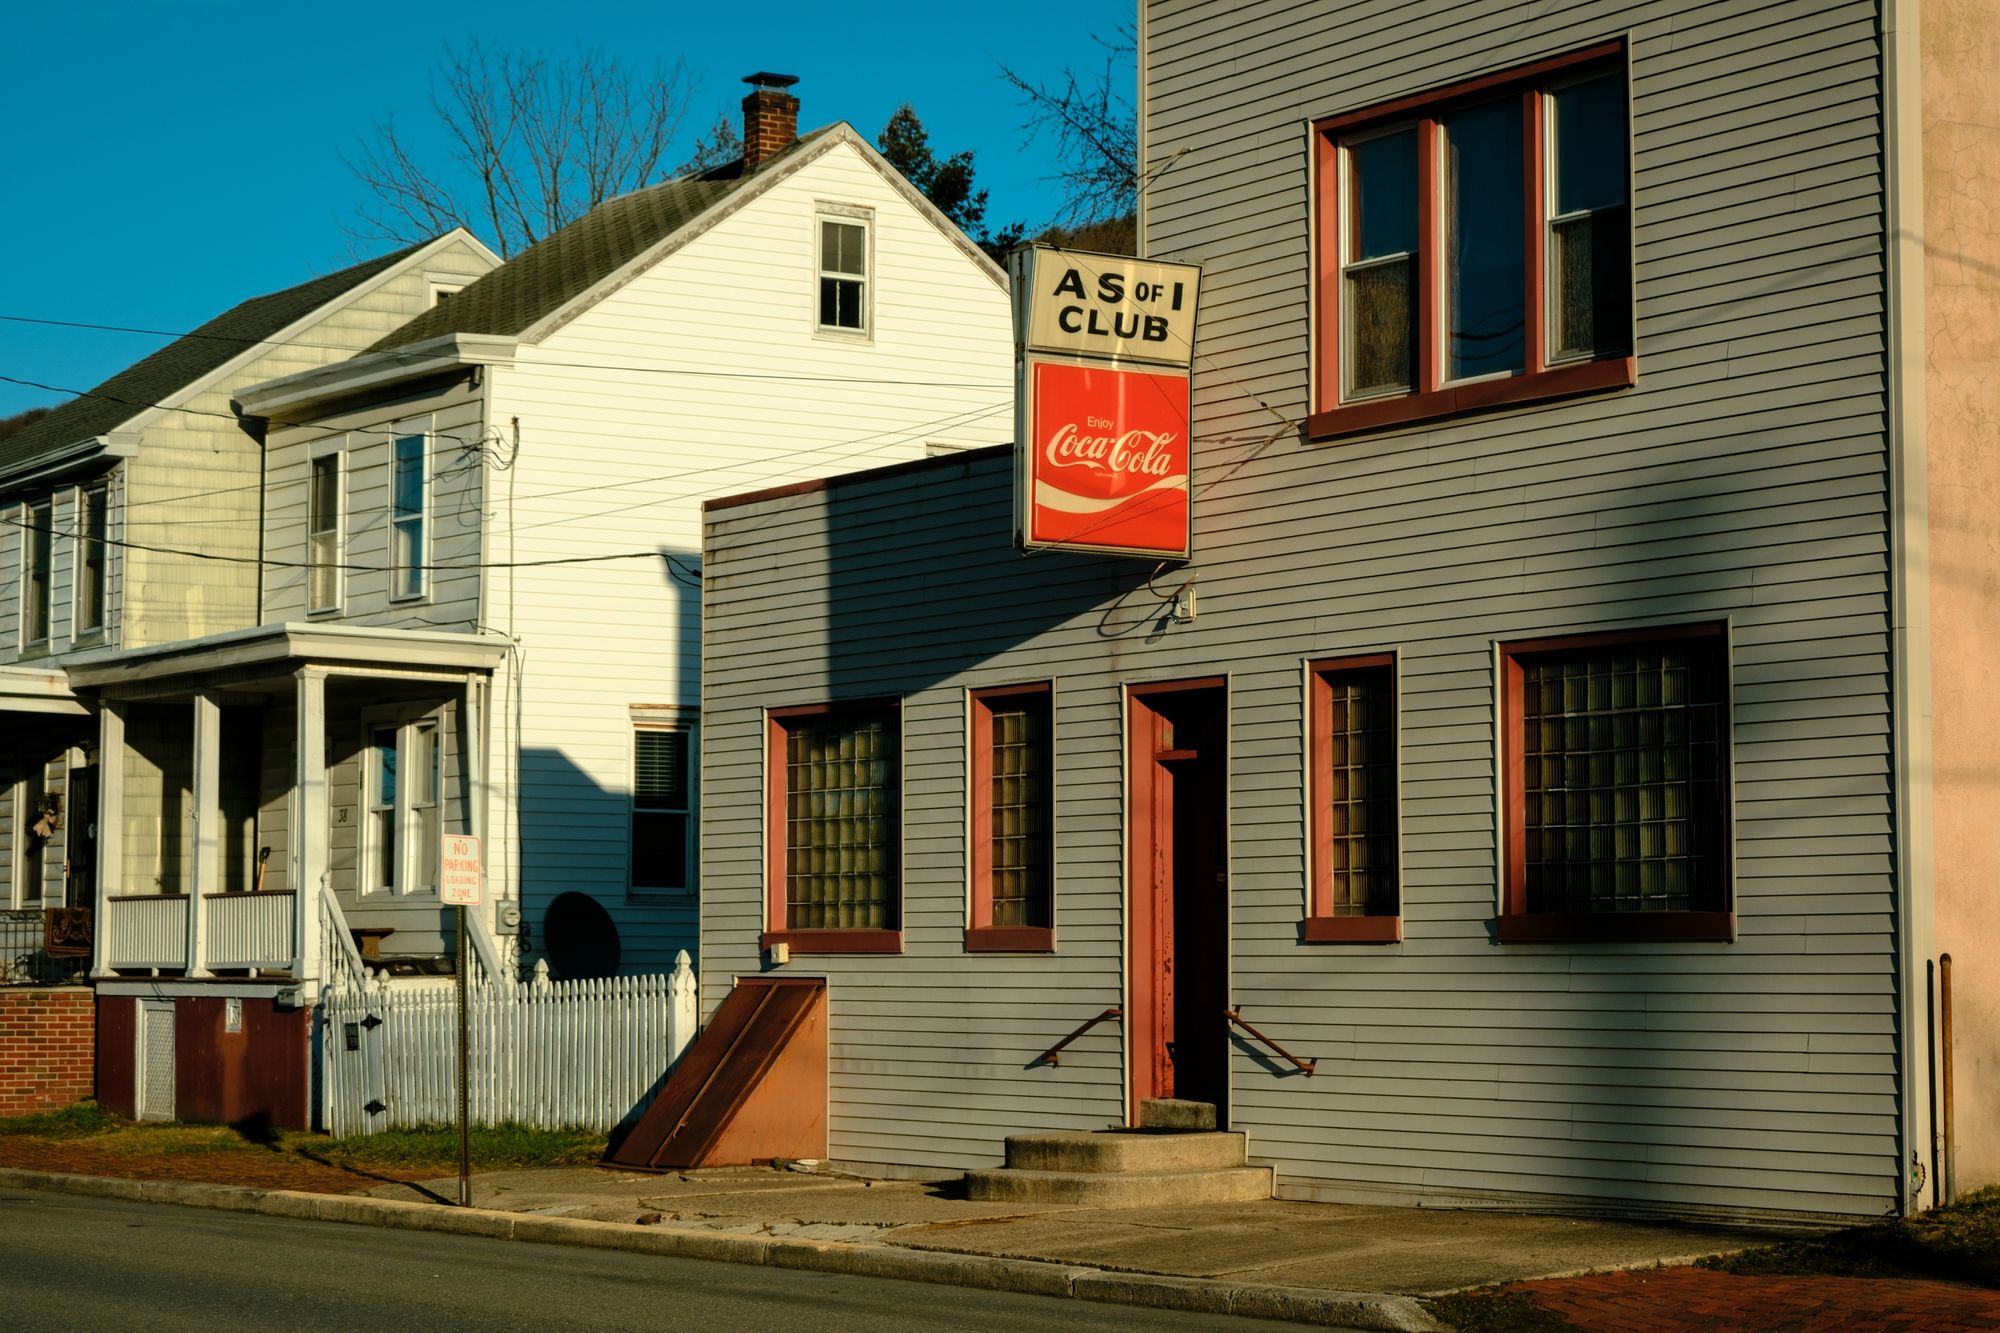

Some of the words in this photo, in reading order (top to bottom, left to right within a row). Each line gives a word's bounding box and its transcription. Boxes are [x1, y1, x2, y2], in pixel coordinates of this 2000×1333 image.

[1134, 281, 1164, 303] OF
[1171, 282, 1184, 311] I
[1058, 305, 1169, 342] CLUB
[1087, 416, 1114, 430] Enjoy
[1046, 423, 1178, 476] Coca-Cola
[453, 842, 468, 855] NO
[444, 859, 478, 872] PARKING
[446, 875, 476, 885] LOADING
[452, 888, 471, 898] ZONE
